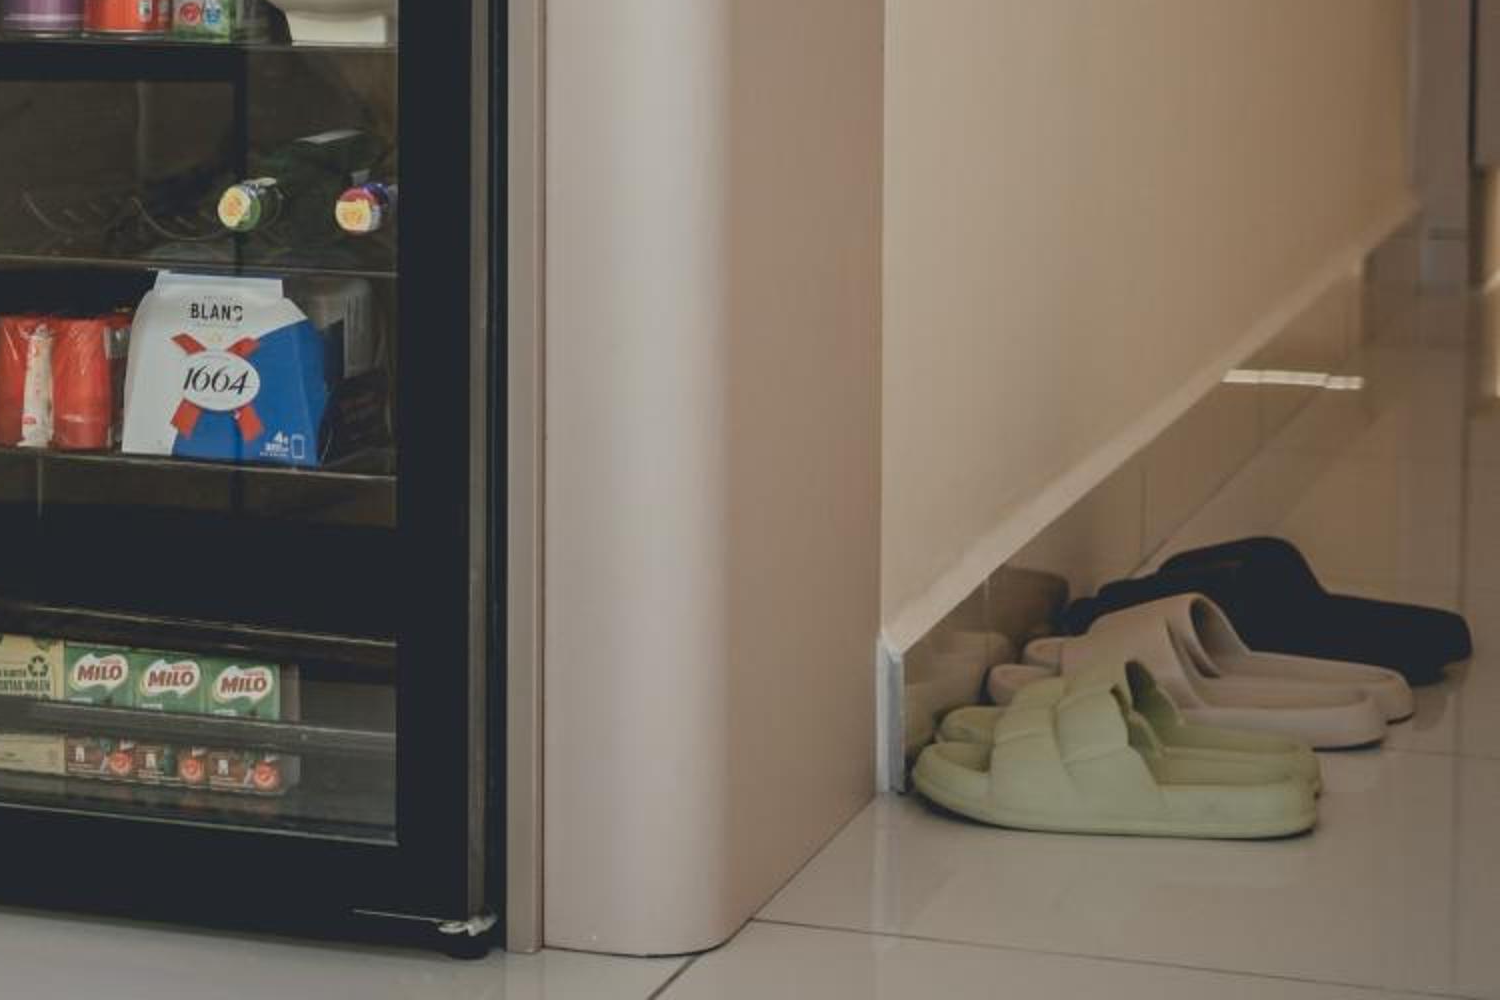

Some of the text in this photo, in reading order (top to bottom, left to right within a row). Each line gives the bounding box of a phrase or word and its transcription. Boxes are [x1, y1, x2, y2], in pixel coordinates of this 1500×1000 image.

[183, 366, 251, 394] 1664
[77, 663, 123, 681] MILO
[147, 670, 195, 687] MILO
[220, 676, 267, 693] MILO
